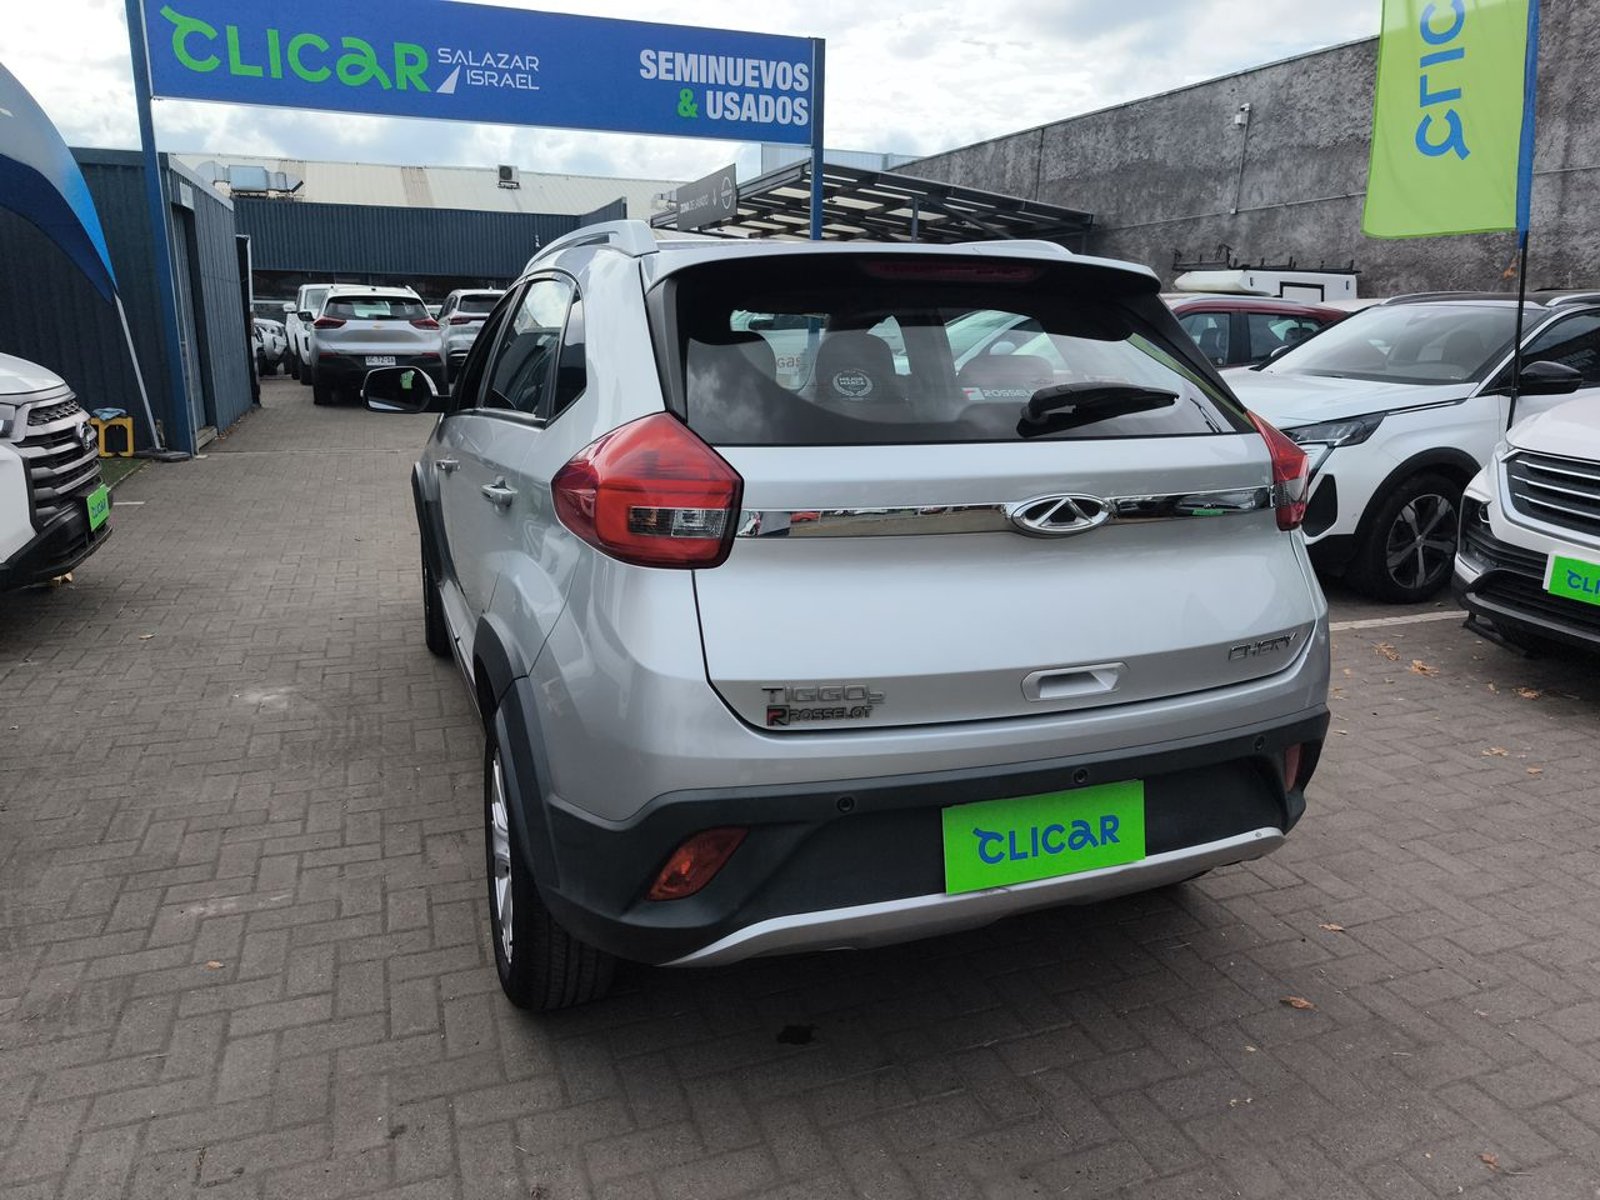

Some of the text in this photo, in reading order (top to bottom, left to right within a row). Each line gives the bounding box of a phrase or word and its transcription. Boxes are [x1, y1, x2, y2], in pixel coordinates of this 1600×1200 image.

[438, 47, 540, 72] SALAZAR
[639, 49, 810, 92] SEMINUEVOS
[466, 69, 540, 90] ISRAEL
[677, 88, 809, 126] & USADOS
[1228, 632, 1298, 661] CHERY
